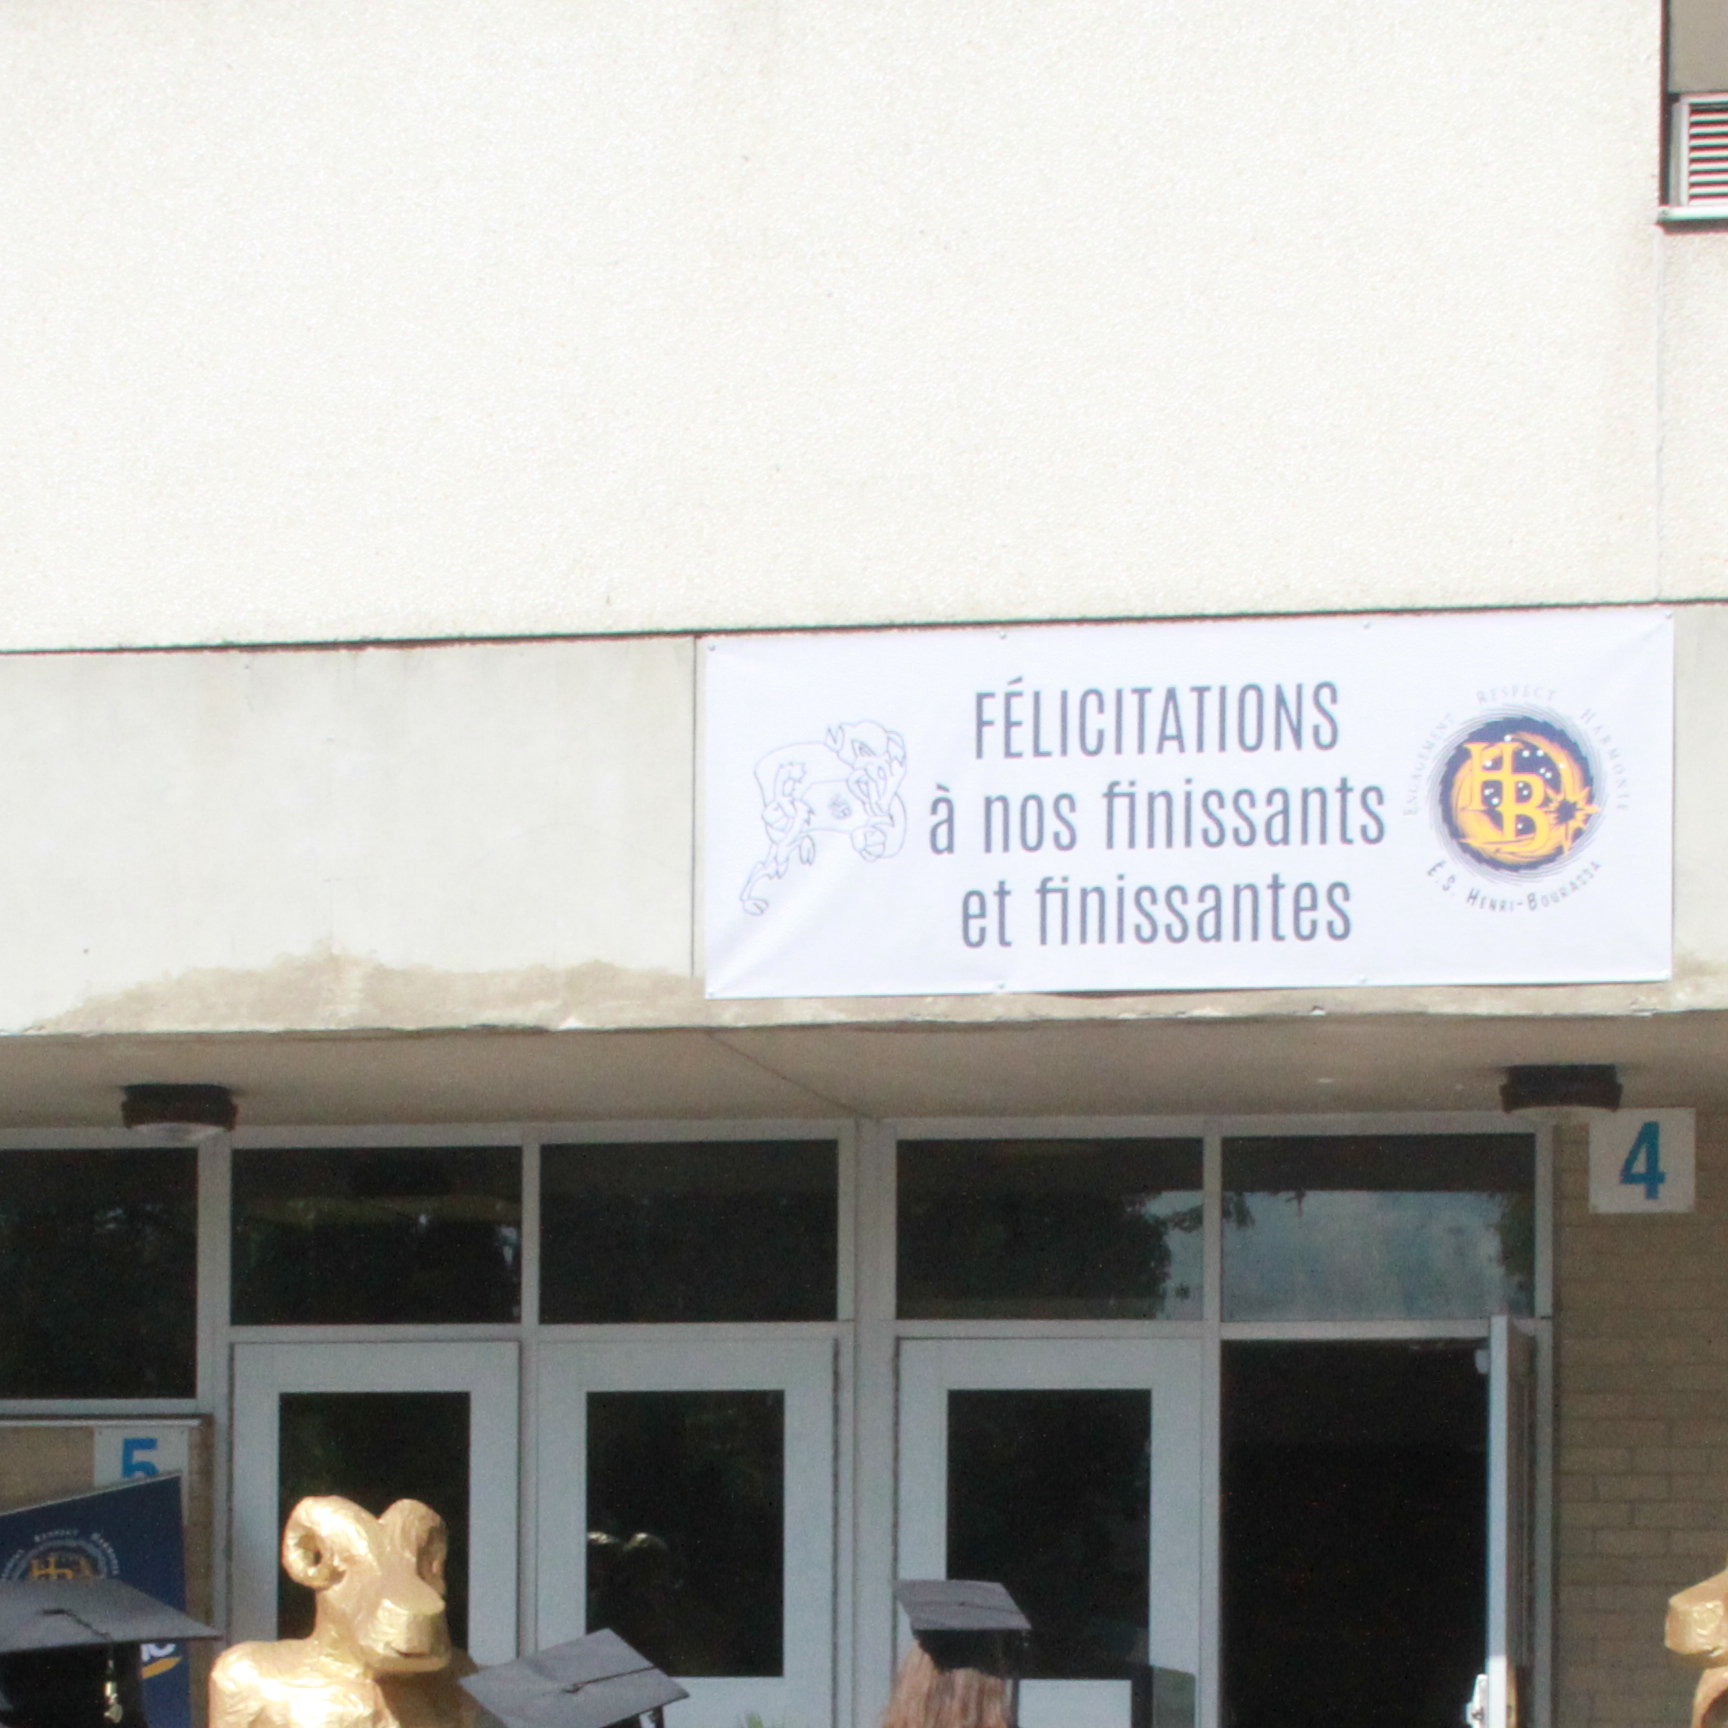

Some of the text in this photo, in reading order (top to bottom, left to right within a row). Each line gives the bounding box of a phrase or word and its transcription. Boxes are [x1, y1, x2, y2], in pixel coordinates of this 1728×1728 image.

[975, 675, 1339, 760] FÉLICITATIONS
[1475, 684, 1558, 705] RESPECT
[1403, 711, 1456, 816] ENGAGEMENT
[1580, 707, 1631, 811] HARMONIE
[929, 776, 1386, 856] à nos finissants
[961, 872, 1353, 949] et finissantes
[1619, 1120, 1667, 1200] 4
[121, 1437, 160, 1479] 5
